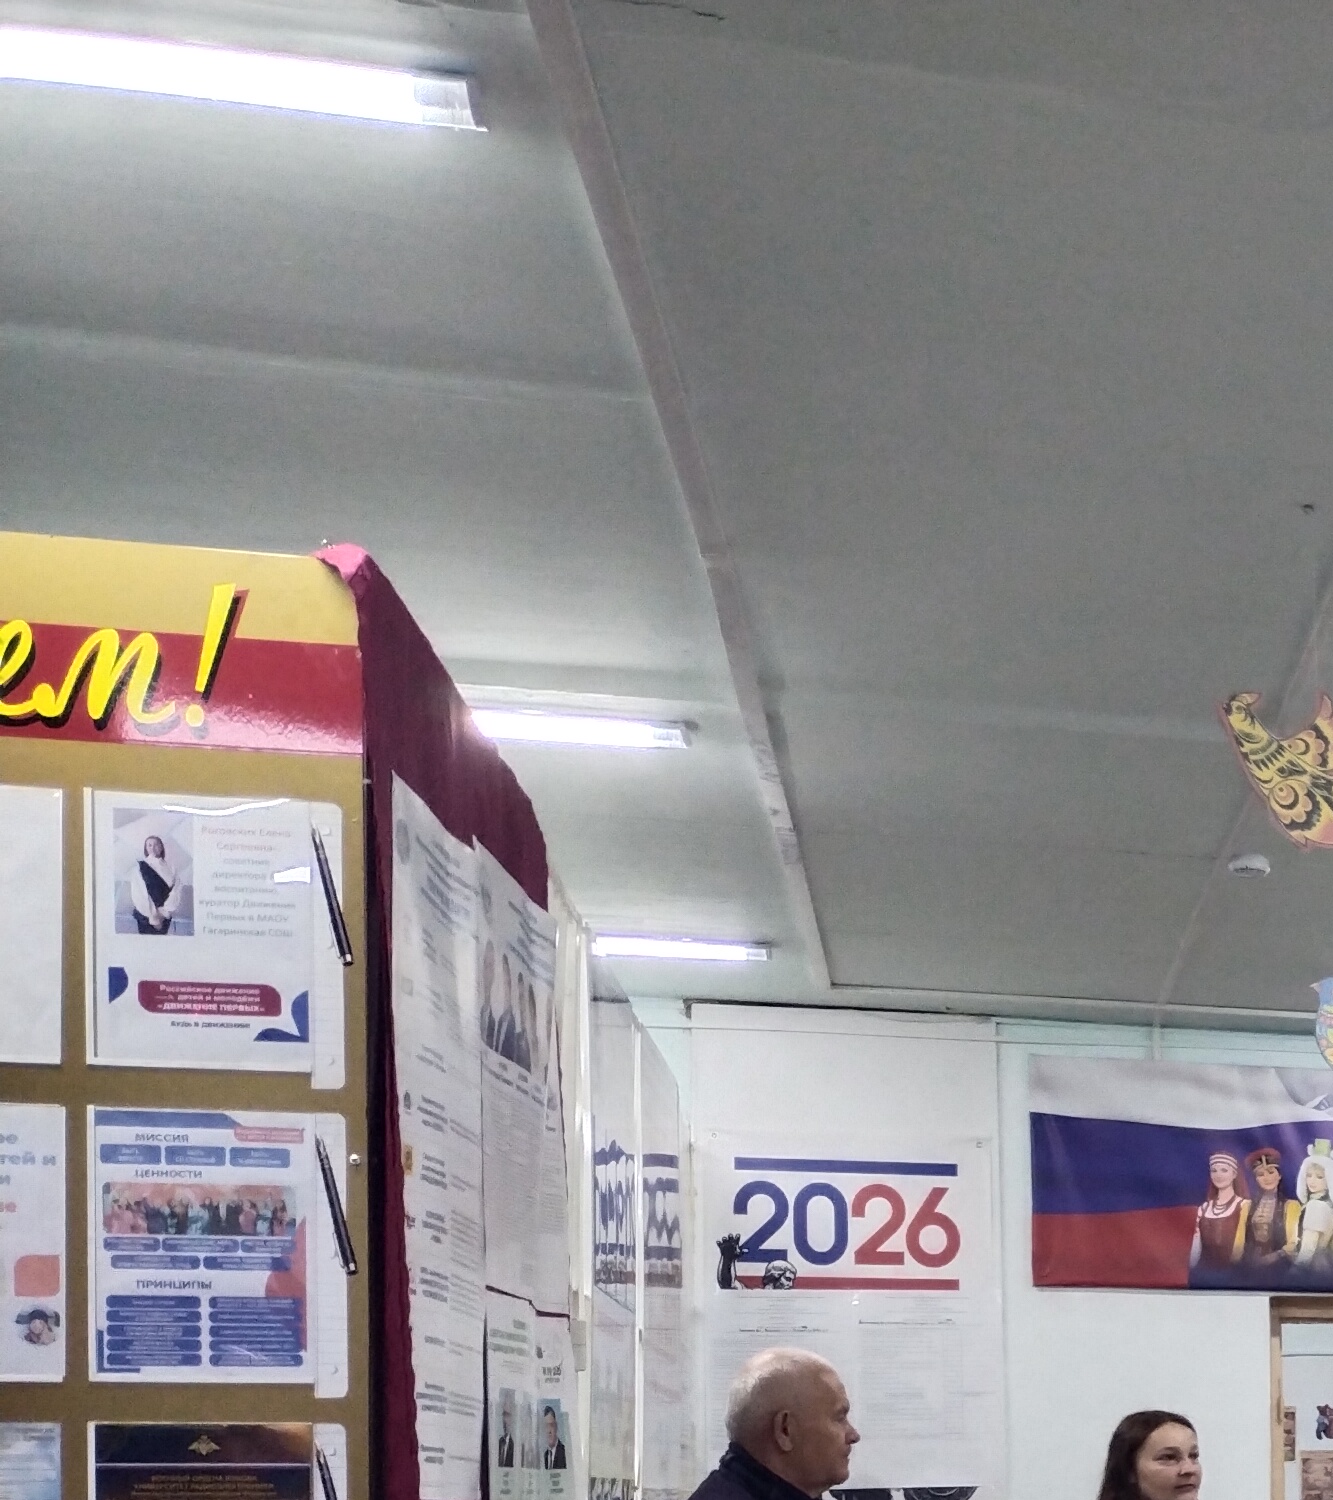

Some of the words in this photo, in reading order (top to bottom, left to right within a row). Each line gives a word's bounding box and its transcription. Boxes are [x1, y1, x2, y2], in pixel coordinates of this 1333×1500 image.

[198, 899, 240, 909] куратор
[135, 1133, 189, 1143] МИССИЯ
[134, 1168, 203, 1180] ЦЕННОСТИ
[733, 1180, 961, 1268] 2026
[136, 1279, 212, 1290] ПРИНЦИПЫ
